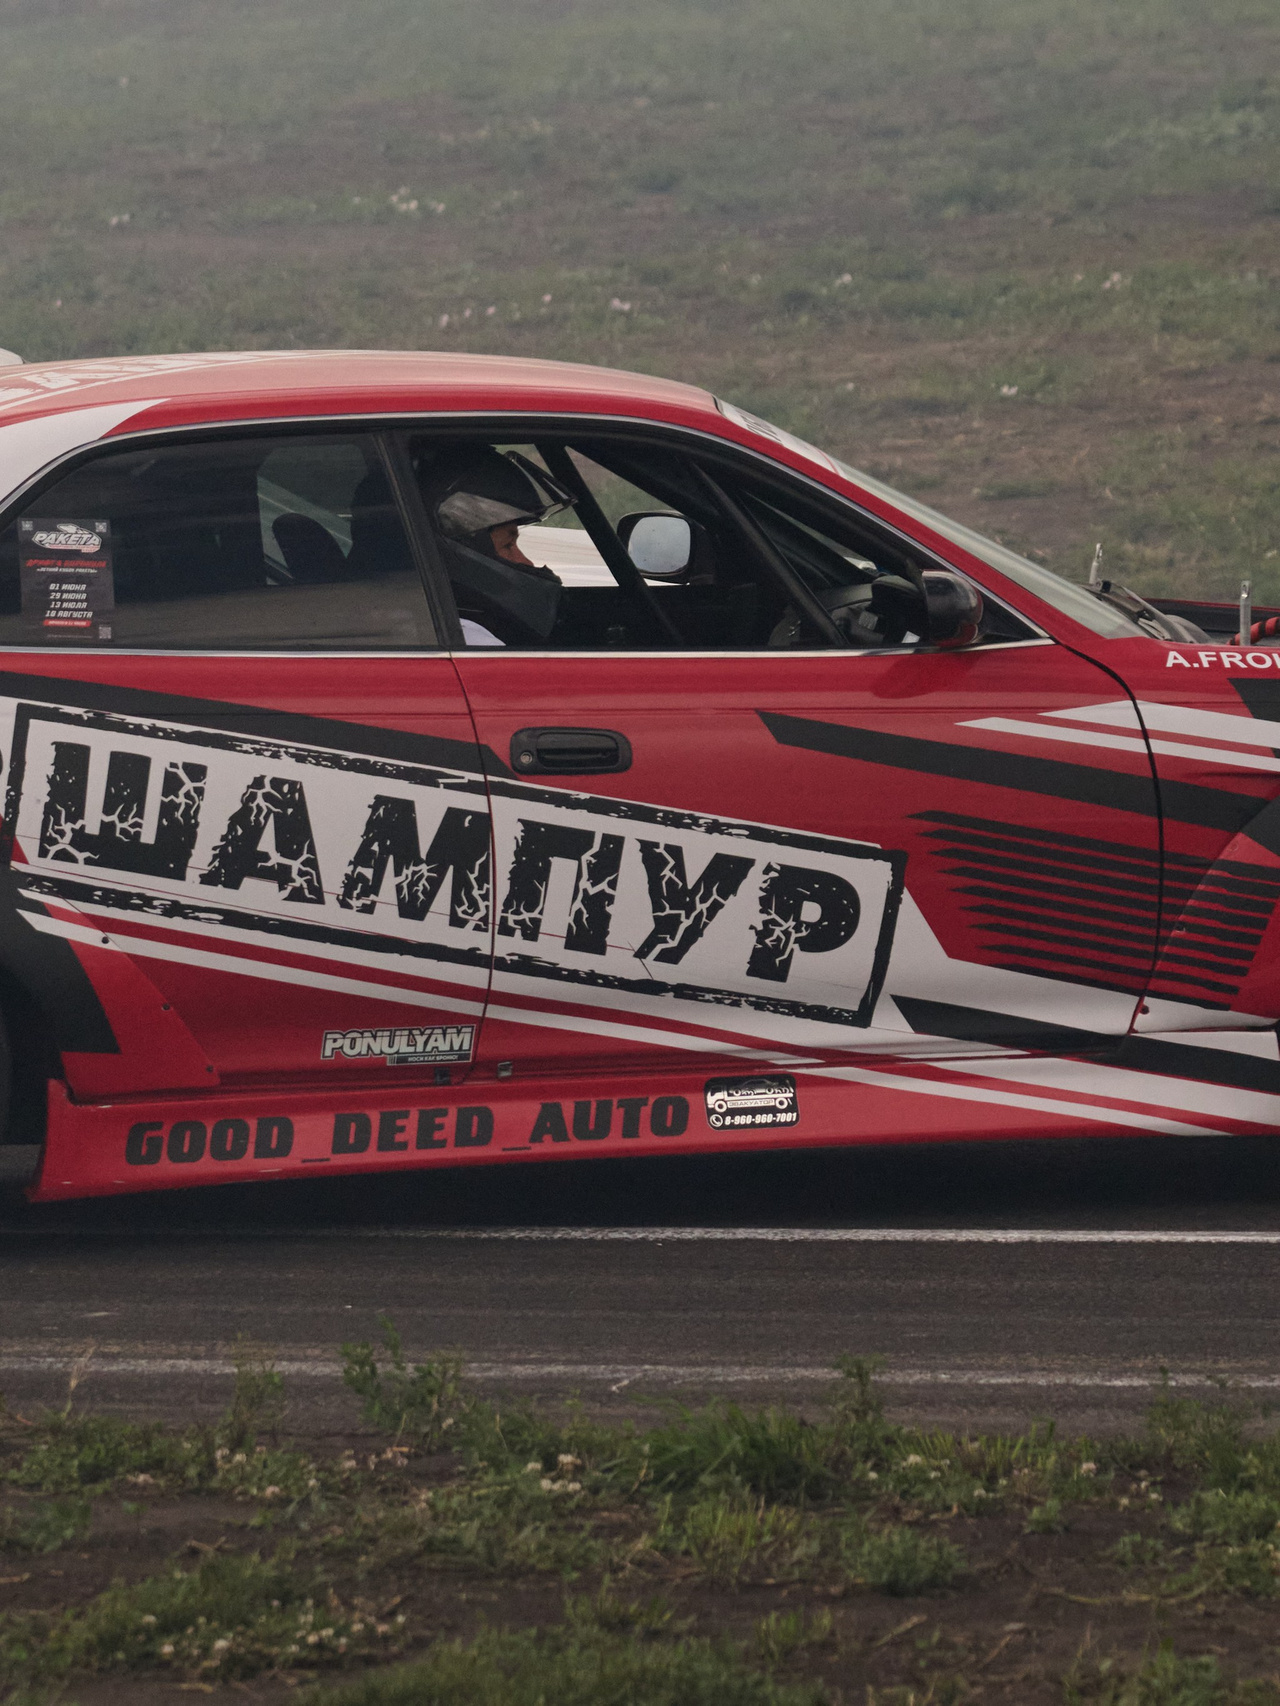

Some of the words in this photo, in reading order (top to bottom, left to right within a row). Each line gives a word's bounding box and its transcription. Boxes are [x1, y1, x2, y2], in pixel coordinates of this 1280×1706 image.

[34, 532, 101, 546] РАКЕТА
[49, 583, 60, 591] 01
[61, 583, 87, 591] ИЮНЯ
[49, 592, 61, 600] 29
[61, 592, 87, 600] ИЮНЯ
[50, 601, 62, 609] 13
[62, 601, 88, 609] ИЮЛЯ
[57, 610, 93, 618] АВГУСТА
[38, 740, 861, 983] ШАМПУР
[322, 1025, 475, 1058] PONULYAM
[729, 1100, 774, 1108] ЭВАКУАТОР
[724, 1112, 797, 1126] 8-960-960-7001
